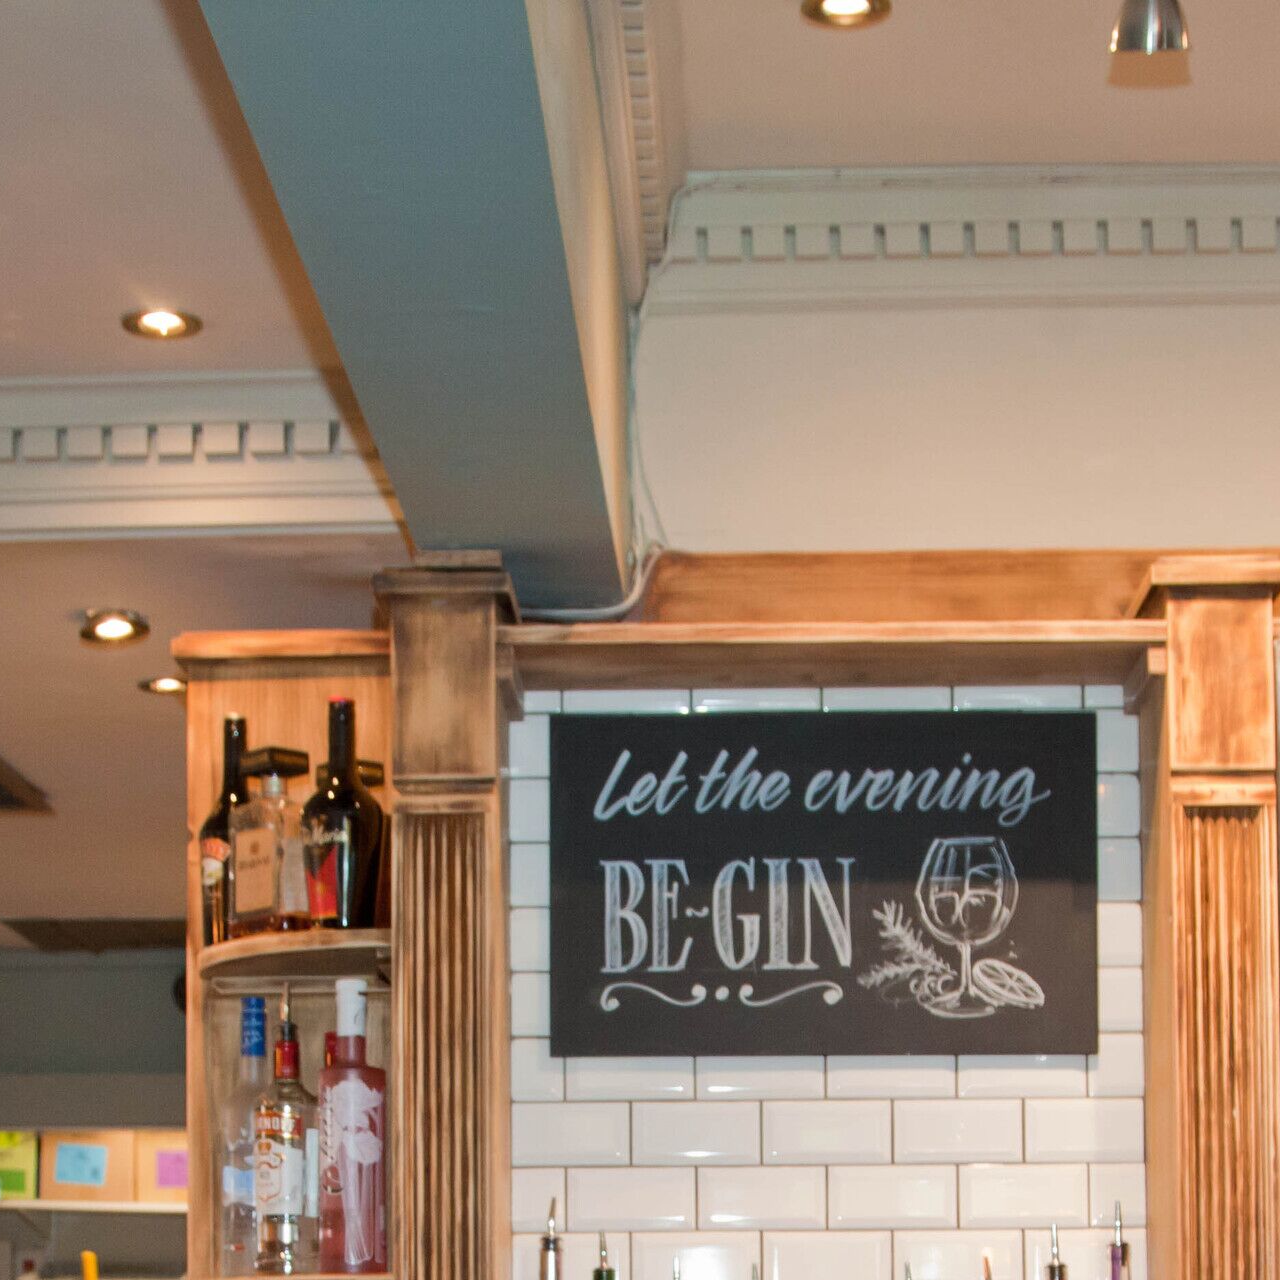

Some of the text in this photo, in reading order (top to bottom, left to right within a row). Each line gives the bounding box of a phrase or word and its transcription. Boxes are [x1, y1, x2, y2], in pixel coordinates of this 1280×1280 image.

[593, 747, 1051, 828] Let the evening
